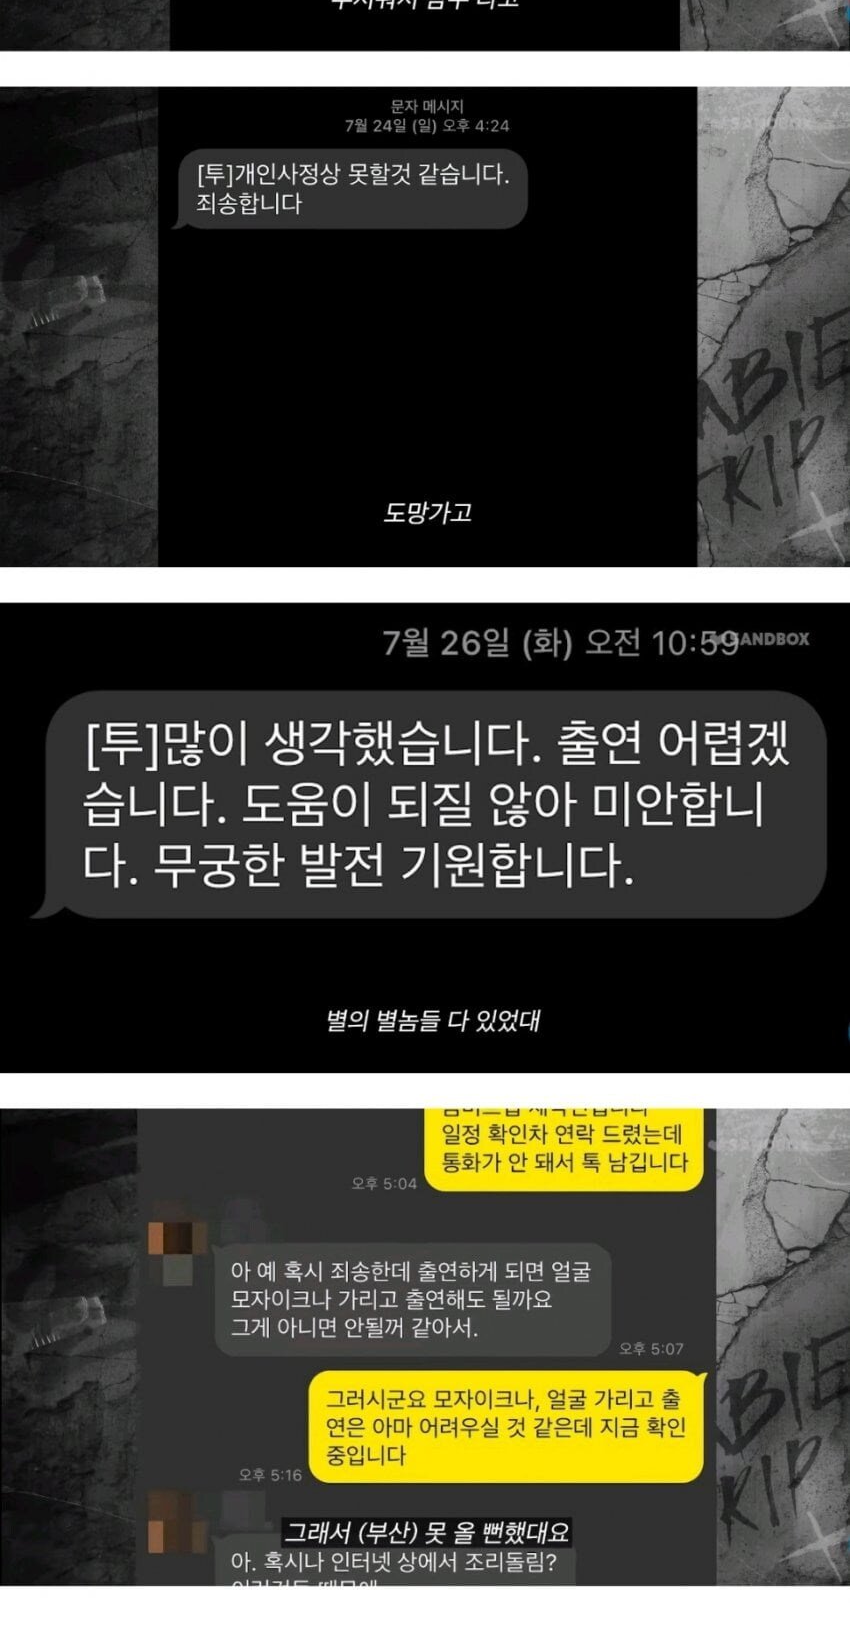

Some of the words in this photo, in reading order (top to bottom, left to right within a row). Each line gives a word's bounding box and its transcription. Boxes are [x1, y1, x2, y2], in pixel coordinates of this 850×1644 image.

[198, 162, 341, 188] [투]개인사정상
[348, 162, 411, 186] 못할것
[418, 162, 510, 186] 같습니다.
[196, 192, 303, 216] 죄송합니다
[382, 627, 429, 658] 7월
[441, 627, 509, 658] 26일
[523, 627, 572, 662] (화)
[585, 627, 640, 657] 오전
[652, 629, 741, 656] 10:59
[87, 720, 246, 772] [투]많이
[264, 720, 541, 767] 생각했습니다.
[557, 720, 641, 766] 출연
[659, 720, 790, 767] 어렵겠
[83, 781, 226, 828] 습니다.
[242, 781, 370, 828] 도움이
[388, 781, 472, 828] 되질
[489, 781, 578, 828] 않아
[594, 781, 762, 828] 미안합니
[84, 842, 138, 889] 다.
[154, 842, 286, 889] 무궁한
[301, 842, 383, 889] 발전
[402, 842, 633, 889] 기원합니다.
[442, 1123, 480, 1146] 일정
[488, 1123, 549, 1146] 확인차
[555, 1123, 596, 1146] 연락
[602, 1123, 682, 1146] 드렸는데
[442, 1151, 502, 1174] 통화가
[508, 1151, 529, 1173] 안
[534, 1151, 574, 1173] 돼서
[582, 1152, 601, 1174] 톡
[608, 1151, 689, 1174] 남깁니다
[351, 1176, 378, 1191] 오후
[383, 1177, 417, 1191] 5:04
[231, 1261, 252, 1283] 아
[257, 1261, 276, 1283] 예
[284, 1260, 322, 1283] 혹시
[330, 1260, 410, 1283] 죄송한데
[417, 1260, 497, 1283] 출연하게
[505, 1260, 544, 1283] 되면
[551, 1260, 592, 1283] 얼굴
[231, 1288, 332, 1311] 모자이크나
[338, 1288, 399, 1311] 가리고
[405, 1288, 486, 1311] 출연해도
[492, 1288, 553, 1311] 될까요
[231, 1316, 270, 1339] 그게
[277, 1317, 337, 1339] 아니면
[344, 1316, 403, 1339] 안될꺼
[411, 1316, 478, 1339] 같아서.
[326, 1388, 427, 1411] 그러시군요
[433, 1388, 540, 1413] 모자이크나,
[547, 1388, 588, 1411] 얼굴
[594, 1388, 654, 1411] 가리고
[661, 1388, 681, 1411] 출
[326, 1416, 366, 1438] 연은
[372, 1416, 413, 1439] 아마
[419, 1416, 499, 1439] 어려우실
[507, 1416, 526, 1438] 것
[533, 1416, 592, 1439] 같은데
[600, 1416, 640, 1439] 지금
[647, 1416, 685, 1439] 확인
[326, 1444, 407, 1467] 중입니다
[231, 1551, 256, 1573] 아.
[264, 1551, 325, 1573] 혹시나
[331, 1551, 391, 1573] 인터넷
[397, 1551, 457, 1574] 상에서
[464, 1551, 557, 1573] 조리돌림?
